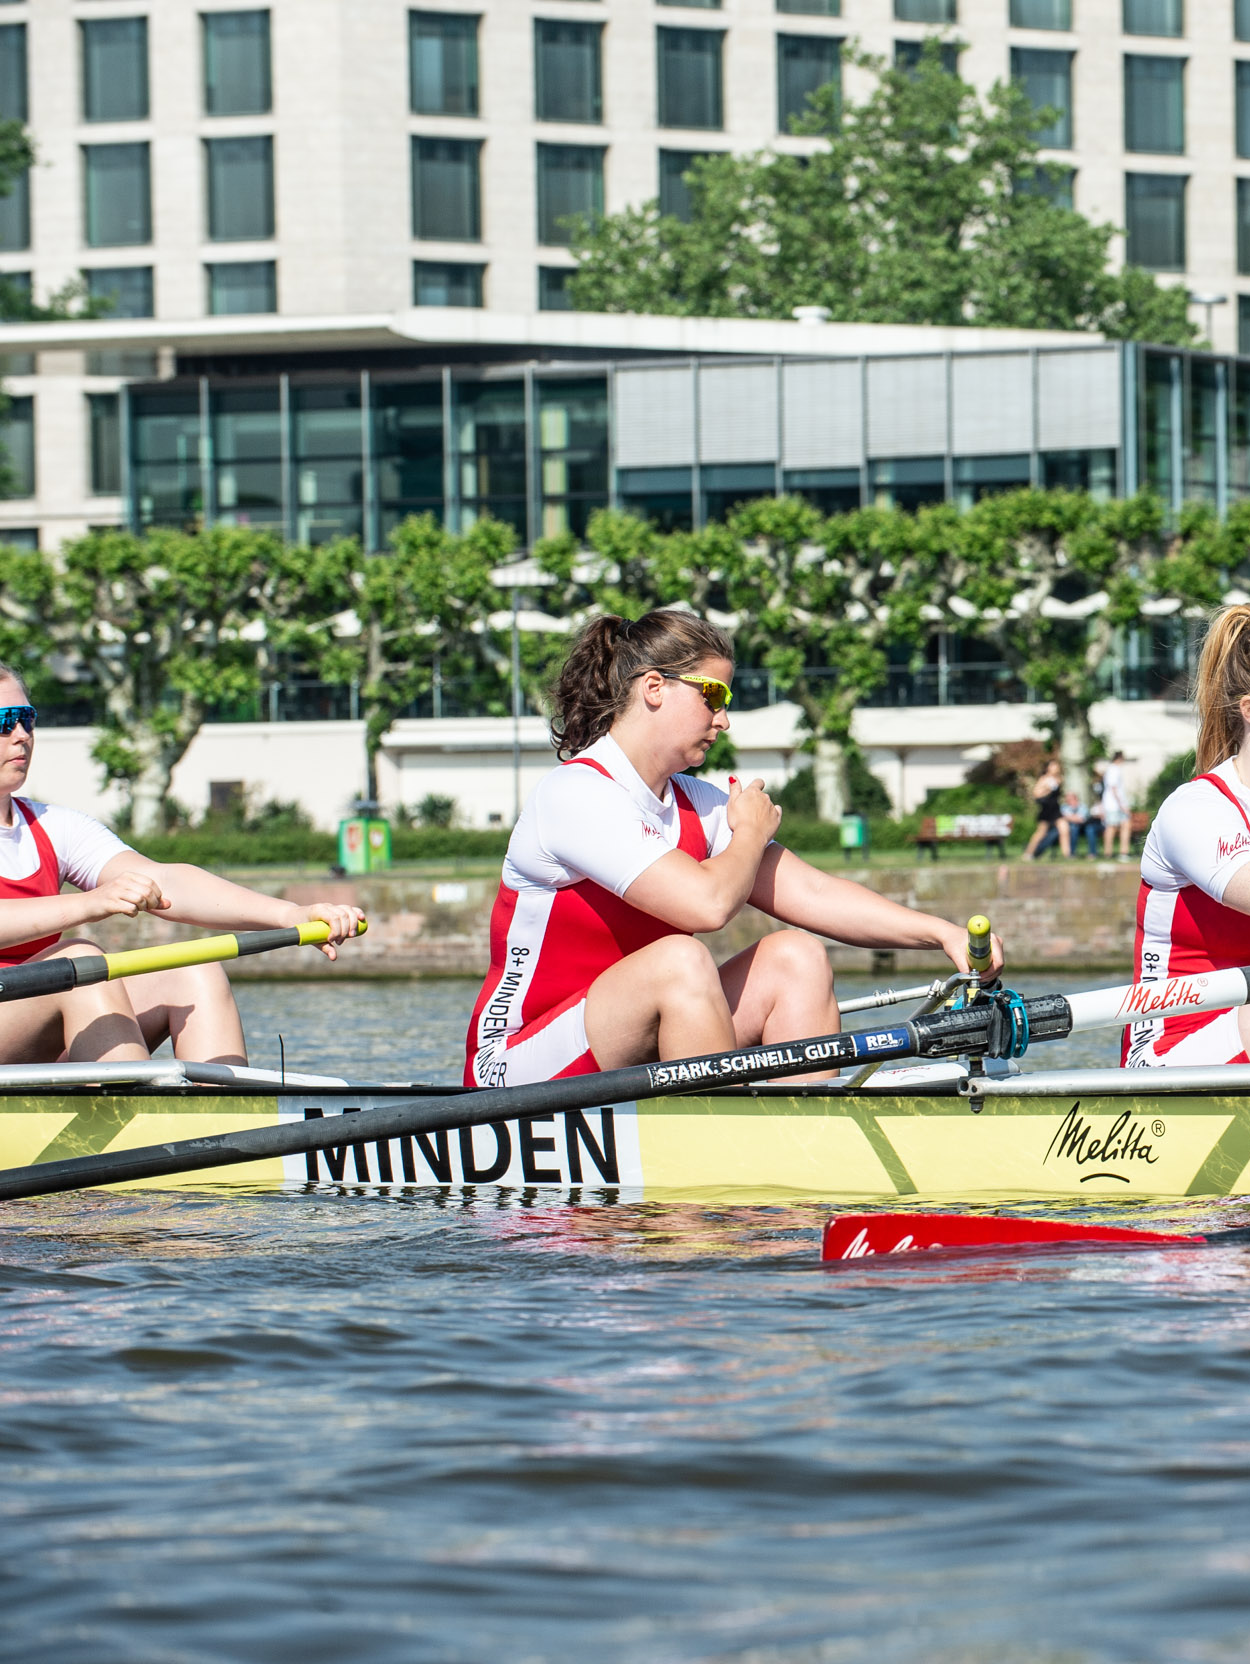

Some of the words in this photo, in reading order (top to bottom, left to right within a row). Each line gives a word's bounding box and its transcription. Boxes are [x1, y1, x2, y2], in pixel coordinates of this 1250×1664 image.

[511, 947, 530, 967] 8+
[1143, 952, 1160, 972] 8+
[865, 1033, 899, 1048] RBL
[657, 1060, 718, 1083] STARK.
[720, 1048, 803, 1074] SCHNELL.
[804, 1041, 845, 1060] GUT.
[302, 1108, 621, 1184] MINDEN
